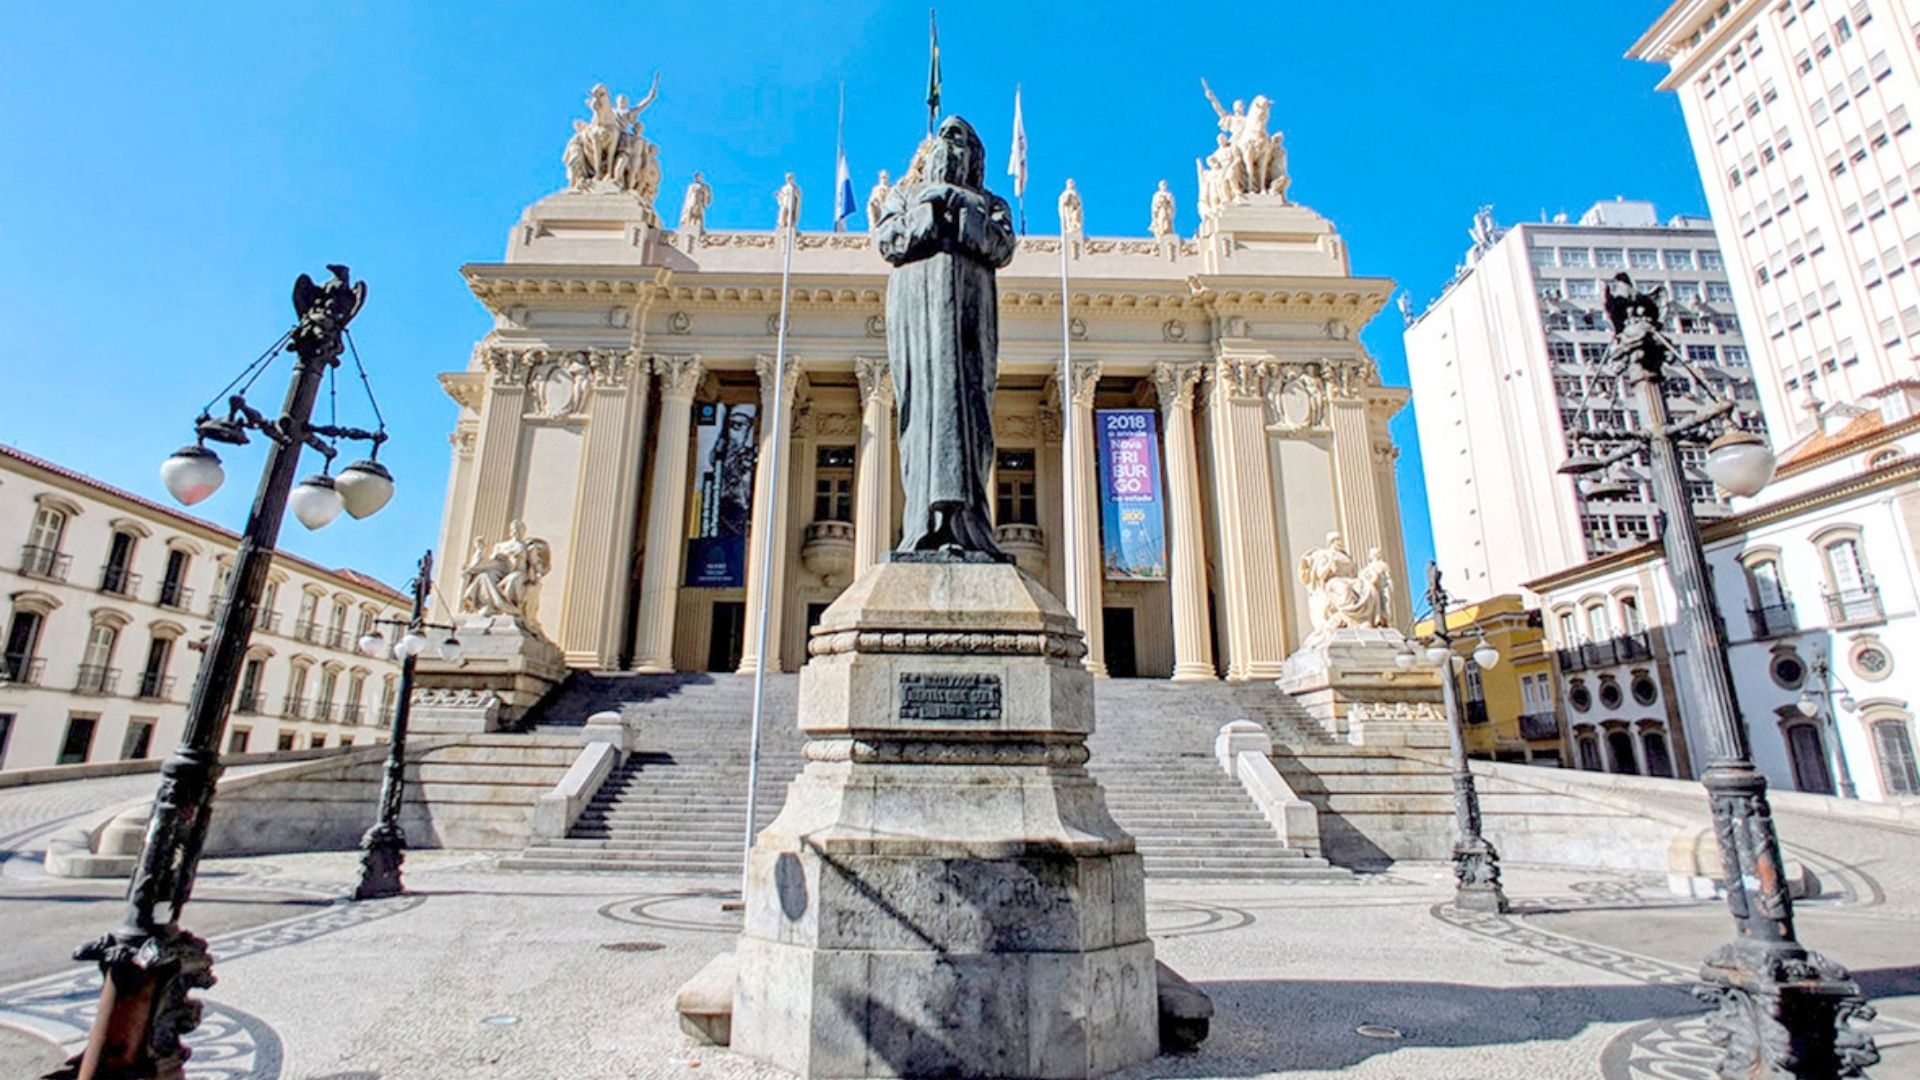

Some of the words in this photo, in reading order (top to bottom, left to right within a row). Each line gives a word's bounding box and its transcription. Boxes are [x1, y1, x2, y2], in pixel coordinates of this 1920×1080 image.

[1107, 415, 1146, 429] 2018
[1110, 438, 1142, 450] Nova
[1111, 450, 1139, 464] FRI
[1113, 464, 1148, 478] BUR
[1114, 478, 1141, 493] GO
